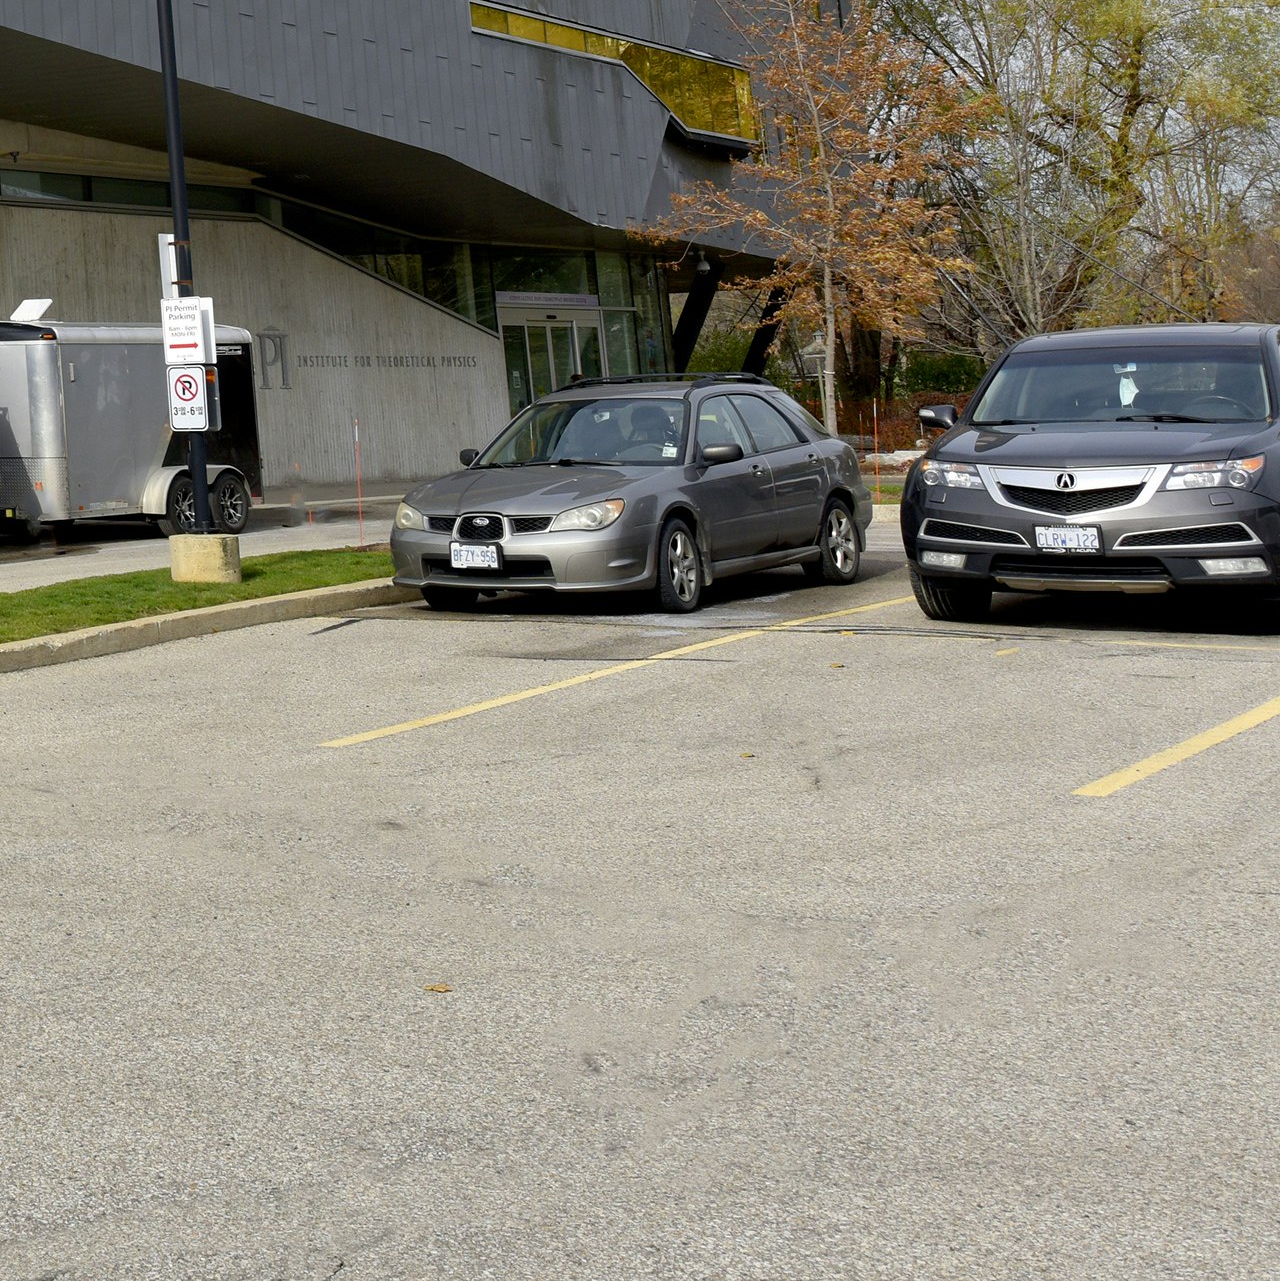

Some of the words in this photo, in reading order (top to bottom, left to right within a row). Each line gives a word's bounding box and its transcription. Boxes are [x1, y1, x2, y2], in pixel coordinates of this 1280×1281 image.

[174, 304, 198, 312] Permit
[168, 313, 196, 321] Parking
[297, 355, 349, 368] INSTITUTE
[354, 355, 371, 368] FOR
[375, 355, 436, 368] THEORETICAL
[441, 355, 477, 368] PHYSICS
[1037, 532, 1068, 547] CLRW
[1076, 533, 1098, 548] 122
[453, 549, 475, 563] BFZY
[480, 550, 497, 564] 956
